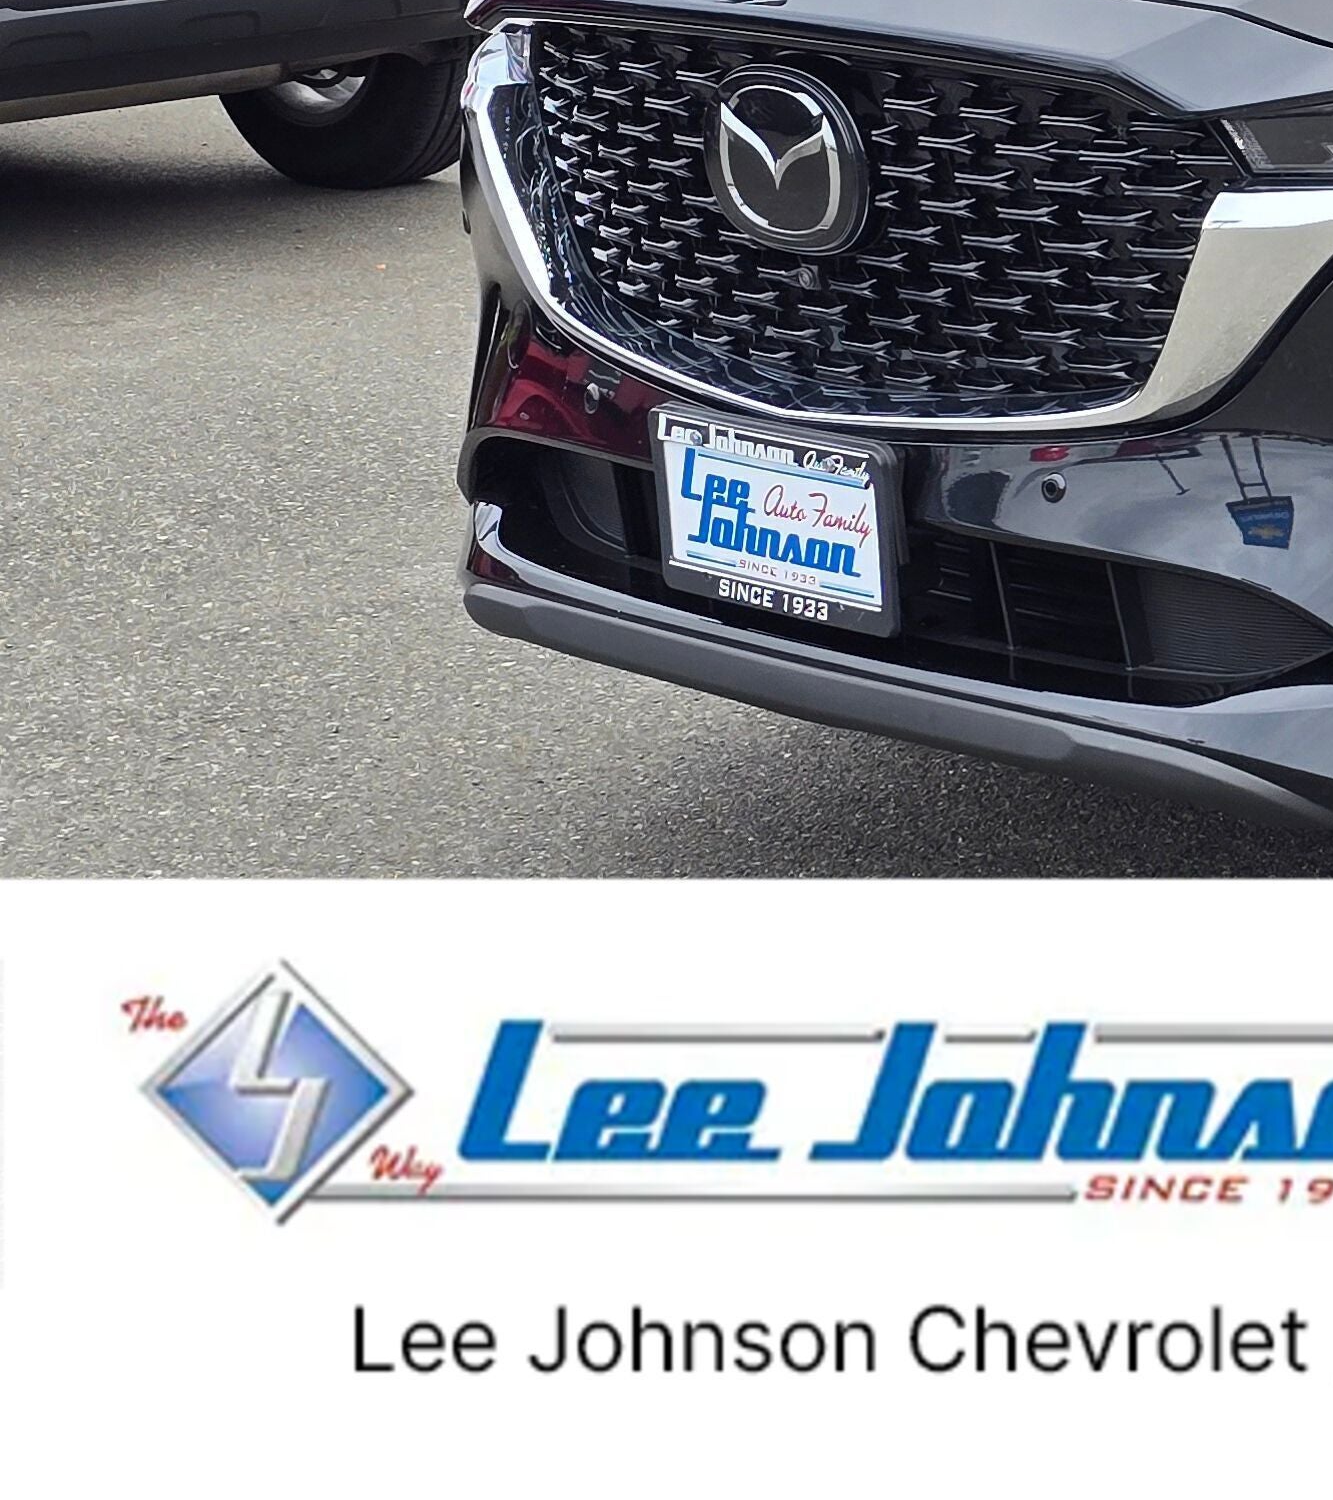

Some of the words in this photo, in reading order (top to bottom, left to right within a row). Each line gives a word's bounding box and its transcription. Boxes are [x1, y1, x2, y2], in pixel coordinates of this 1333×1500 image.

[703, 422, 799, 467] Johnson
[681, 447, 756, 513] Lee
[687, 501, 861, 578] Johnson
[763, 484, 807, 522] Auto
[809, 492, 873, 548] Family
[738, 558, 777, 577] SINCE
[784, 569, 816, 585] 1933
[718, 579, 775, 608] SINCE
[782, 593, 828, 621] 1933
